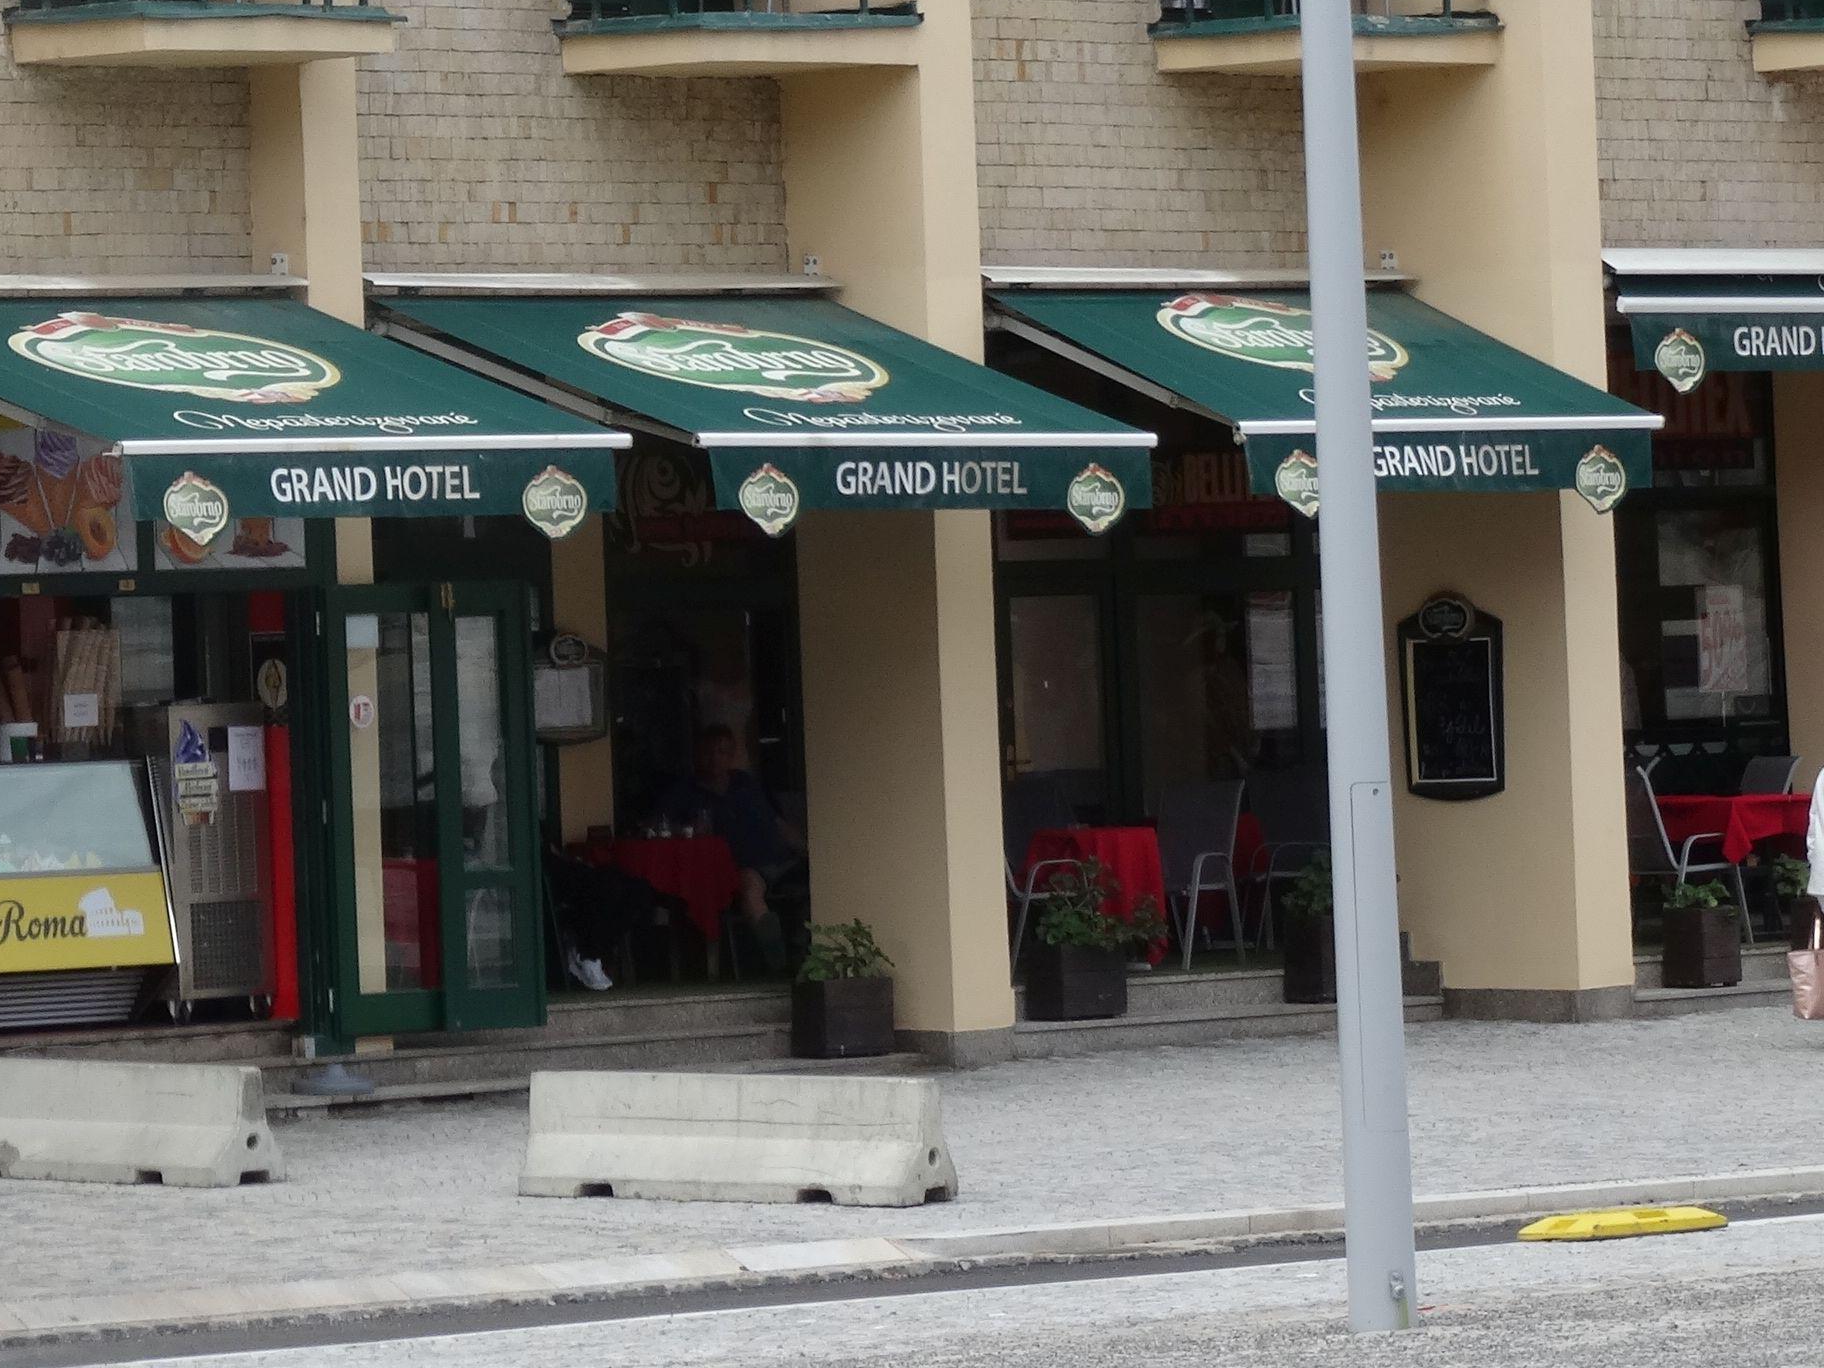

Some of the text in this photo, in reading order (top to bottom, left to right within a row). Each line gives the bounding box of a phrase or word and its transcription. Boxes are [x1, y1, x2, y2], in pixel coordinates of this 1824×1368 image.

[38, 337, 312, 381] Starobrno
[604, 338, 862, 381] Starobrno
[1732, 325, 1816, 357] GRAND
[835, 460, 936, 495] GRAND
[942, 460, 1027, 495] HOTEL
[1373, 444, 1456, 478] GRAND
[1460, 444, 1539, 477] HOTEL
[270, 465, 377, 503] GRAND
[384, 464, 480, 501] HOTEL
